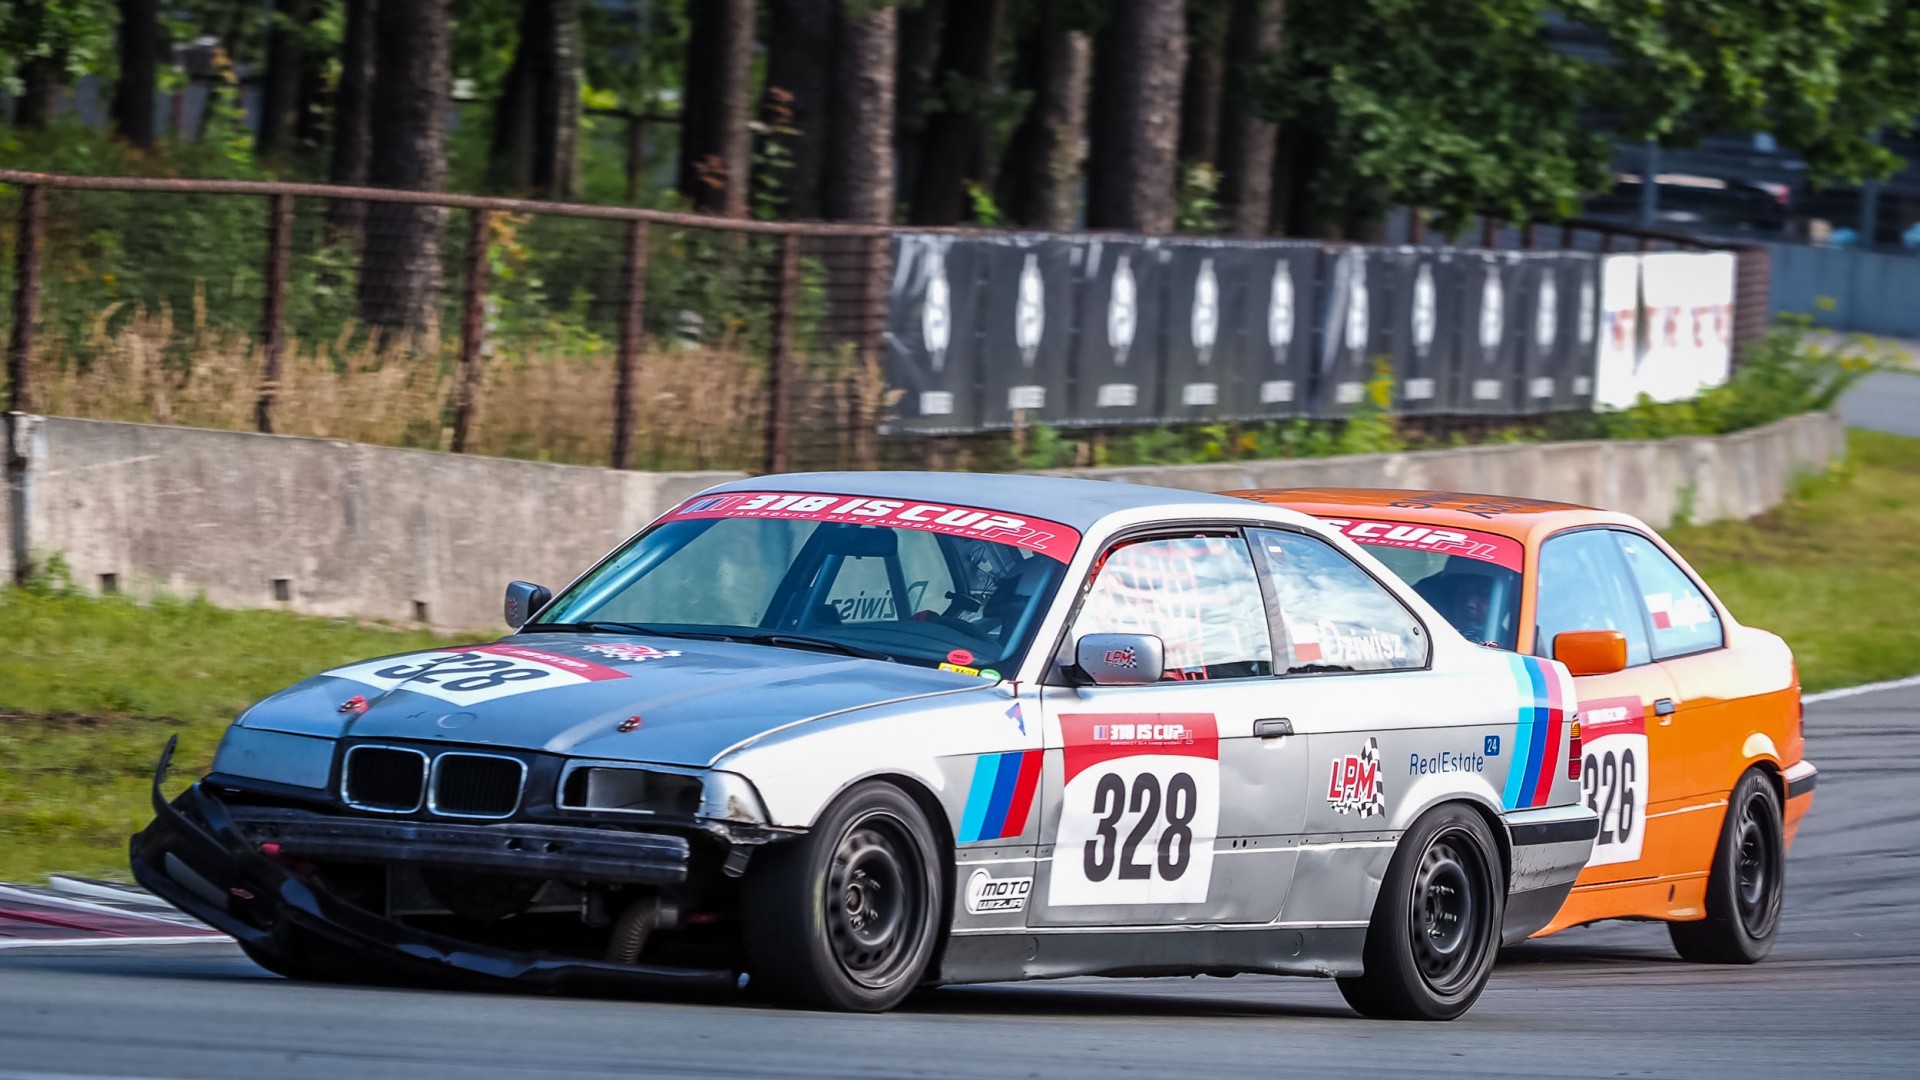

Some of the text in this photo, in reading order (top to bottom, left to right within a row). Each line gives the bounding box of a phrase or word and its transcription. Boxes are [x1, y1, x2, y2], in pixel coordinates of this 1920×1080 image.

[734, 495, 840, 512] 318
[896, 505, 1027, 531] CUP
[1347, 522, 1468, 544] CUP
[1104, 651, 1131, 664] LPM
[373, 652, 550, 692] 328
[1153, 724, 1184, 740] CUP
[1487, 739, 1497, 753] 24
[1410, 751, 1484, 776] RealEstate
[1329, 757, 1377, 803] LPM
[1583, 748, 1635, 845] 326
[1083, 772, 1197, 882] 328
[982, 880, 1031, 896] MOTO
